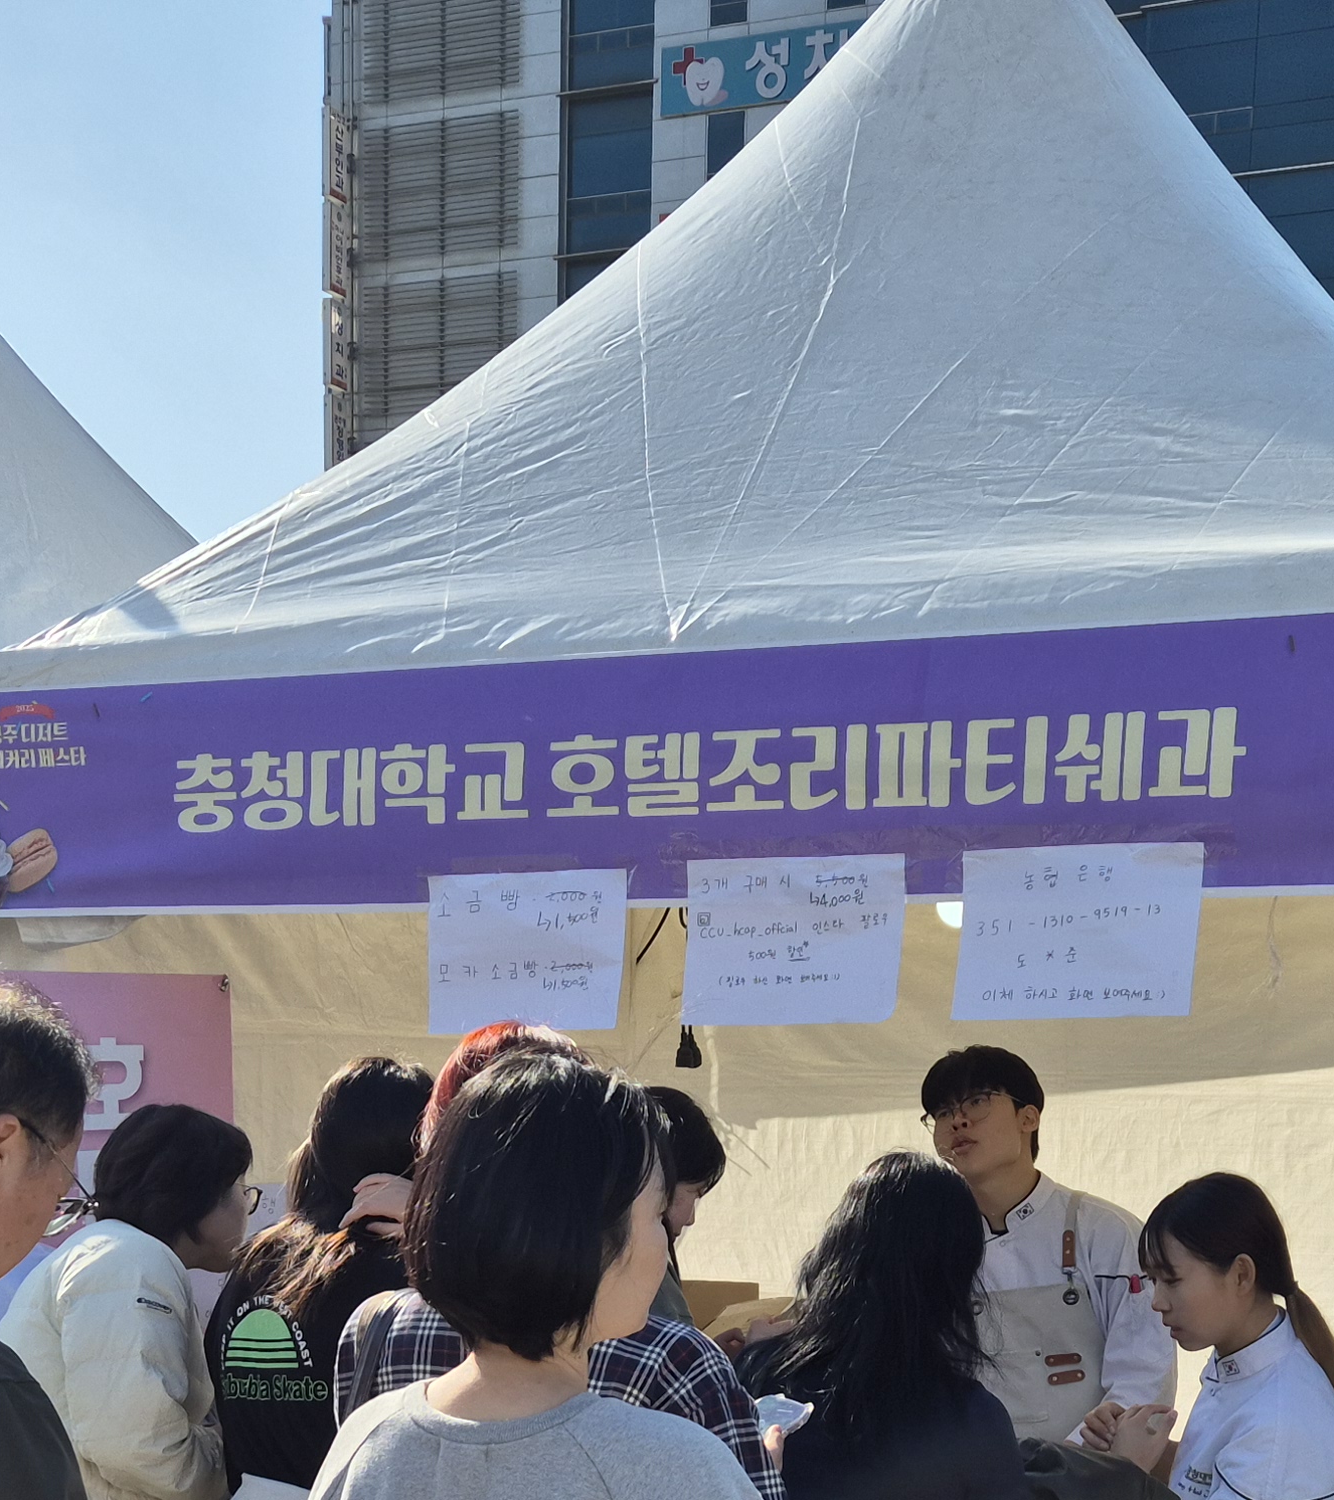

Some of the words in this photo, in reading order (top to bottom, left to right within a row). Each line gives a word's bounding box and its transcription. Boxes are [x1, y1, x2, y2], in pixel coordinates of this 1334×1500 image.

[20, 722, 69, 743] 디저트
[37, 746, 87, 768] 페스타
[172, 740, 530, 834] 충청대학교
[546, 705, 1248, 820] 호텔조리파티쉐과
[743, 874, 768, 893] 구매
[779, 873, 791, 889] 시
[1024, 866, 1059, 891] 농협
[1077, 864, 1113, 883] 은행
[982, 988, 1014, 1001] 이체
[1024, 985, 1059, 1001] 하시고
[226, 1317, 235, 1331] IT
[236, 1301, 250, 1318] ON
[253, 1294, 270, 1307] THE
[291, 1321, 314, 1368] COAST
[272, 1373, 329, 1402] Skate
